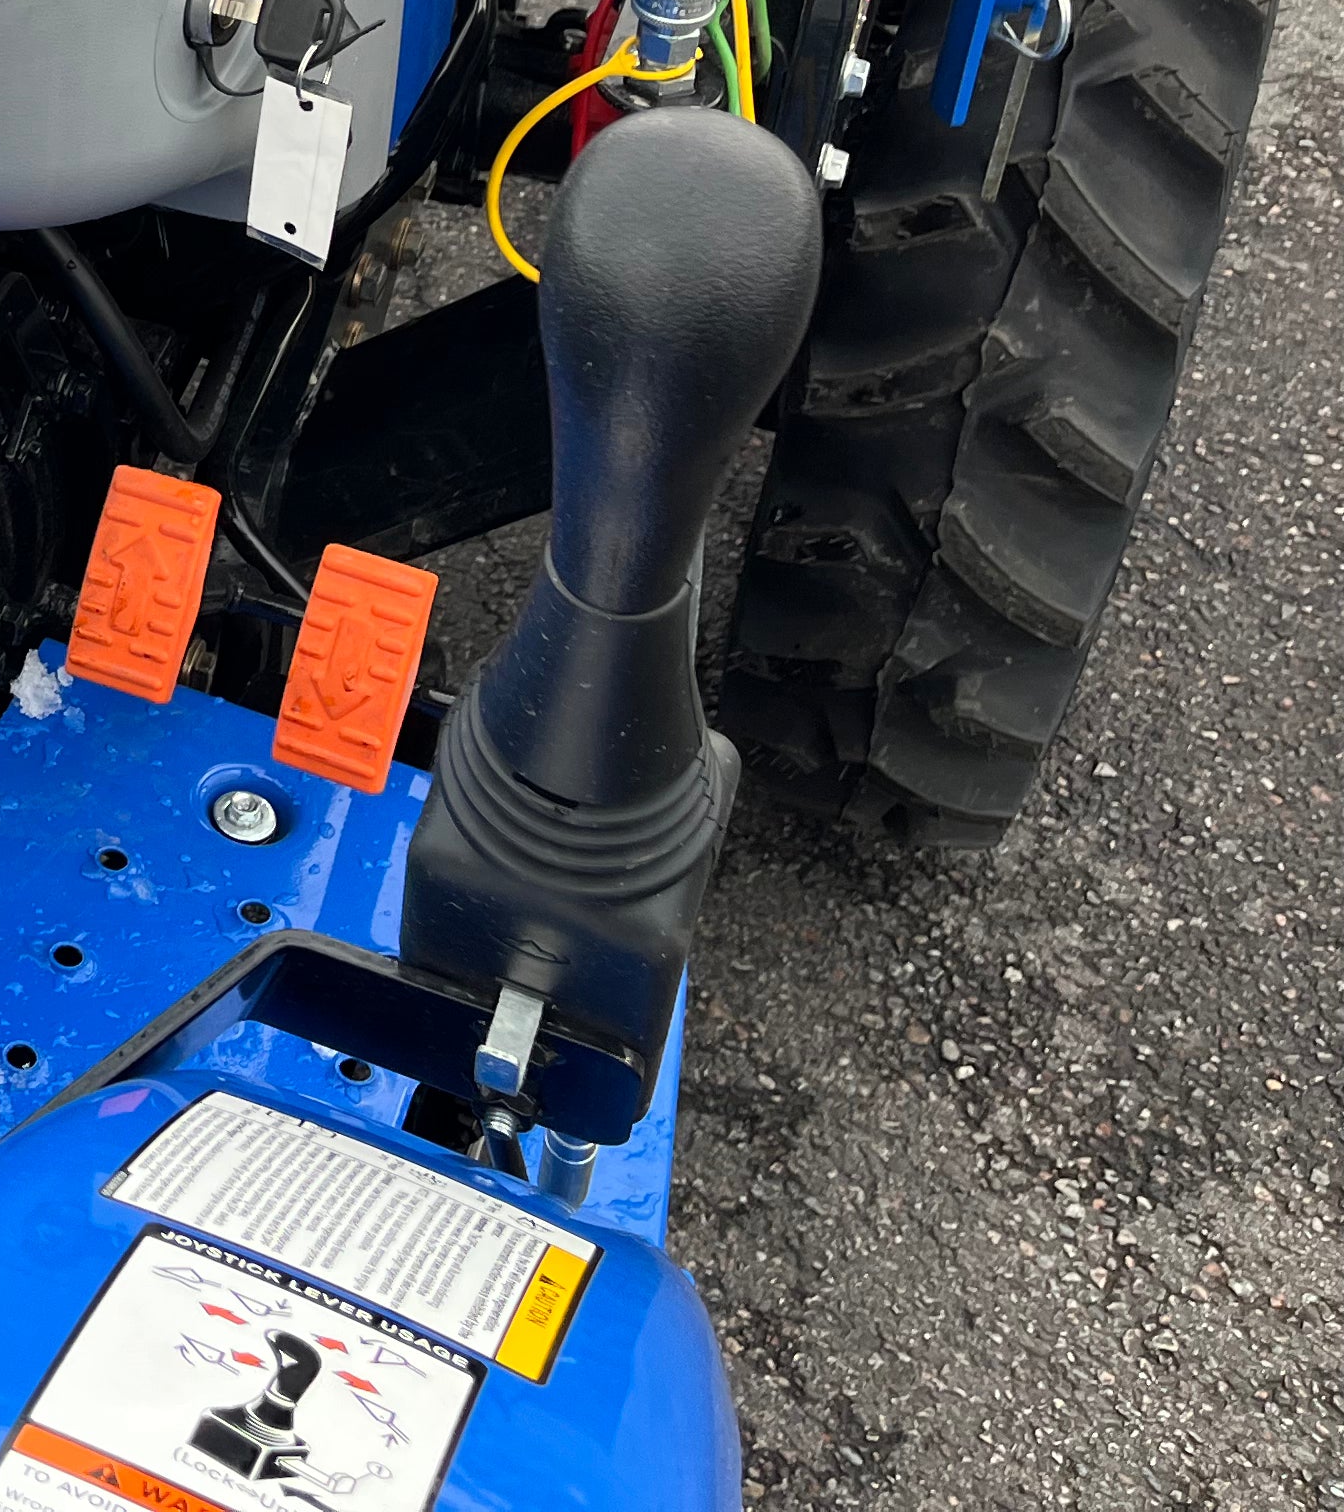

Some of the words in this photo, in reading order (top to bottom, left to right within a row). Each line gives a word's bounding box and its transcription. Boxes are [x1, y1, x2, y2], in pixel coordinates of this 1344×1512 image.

[160, 1230, 282, 1284] JOYSTICK
[287, 1279, 374, 1323] LEVER
[380, 1319, 472, 1369] USAGE
[525, 1285, 561, 1329] CAUTION
[23, 1463, 50, 1484] TO
